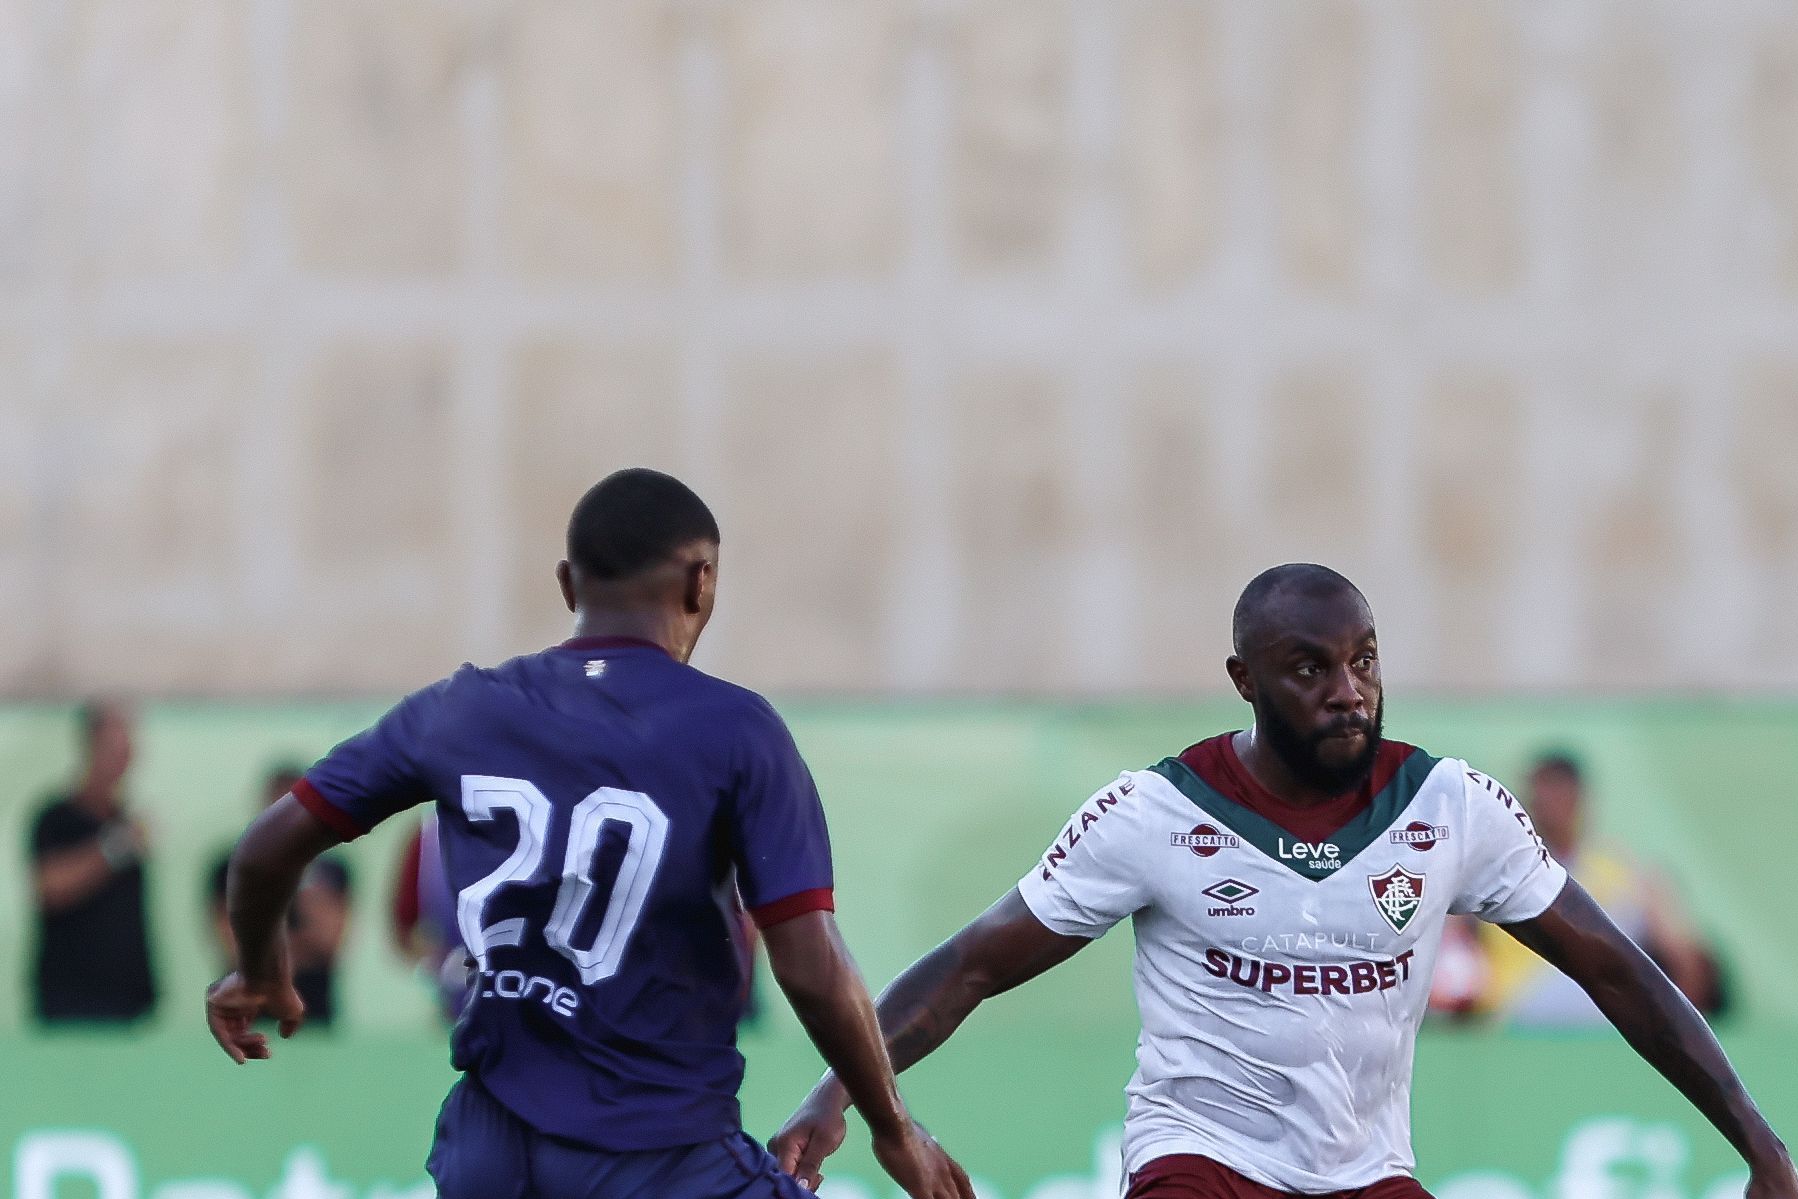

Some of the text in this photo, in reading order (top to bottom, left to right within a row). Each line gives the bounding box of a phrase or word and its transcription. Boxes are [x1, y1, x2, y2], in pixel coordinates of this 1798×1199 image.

[1172, 834, 1237, 848] FRESCATTO
[1278, 837, 1341, 860] Leve
[1308, 856, 1343, 870] saúde
[458, 775, 668, 986] 20
[1207, 905, 1256, 918] umbro
[1240, 932, 1380, 954] CATAPULT
[1201, 947, 1415, 996] SUPERBET
